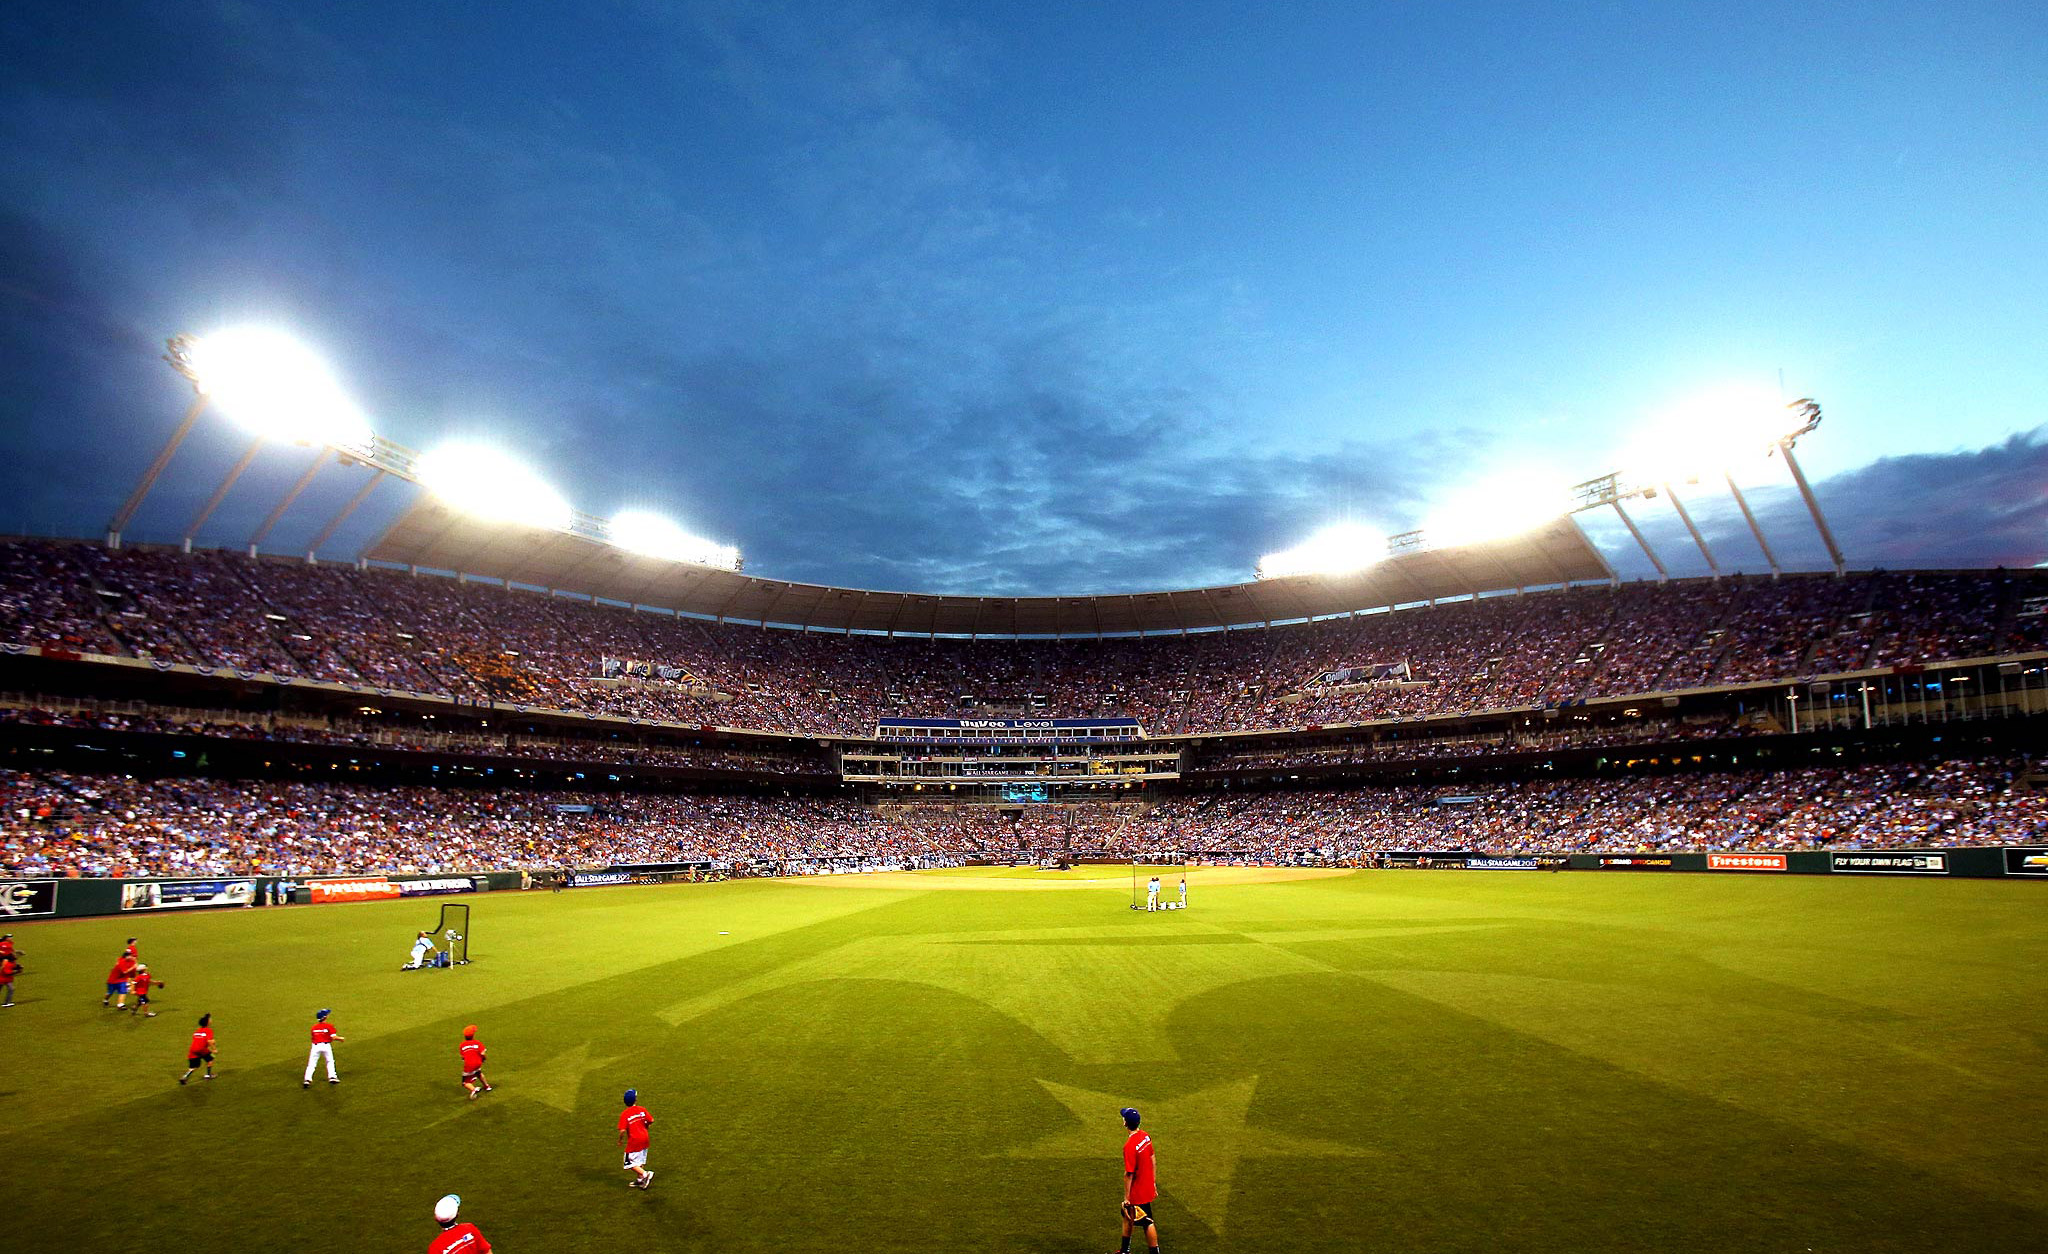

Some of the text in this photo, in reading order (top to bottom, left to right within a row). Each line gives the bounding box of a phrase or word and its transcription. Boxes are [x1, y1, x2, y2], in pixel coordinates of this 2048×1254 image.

[1014, 720, 1054, 728] Level
[1503, 859, 1520, 867] GAME
[1712, 856, 1781, 867] Firestone
[1834, 857, 1849, 866] FLY
[1850, 858, 1871, 866] YOUR
[1871, 858, 1891, 866] OWN
[1892, 858, 1913, 867] FLAG
